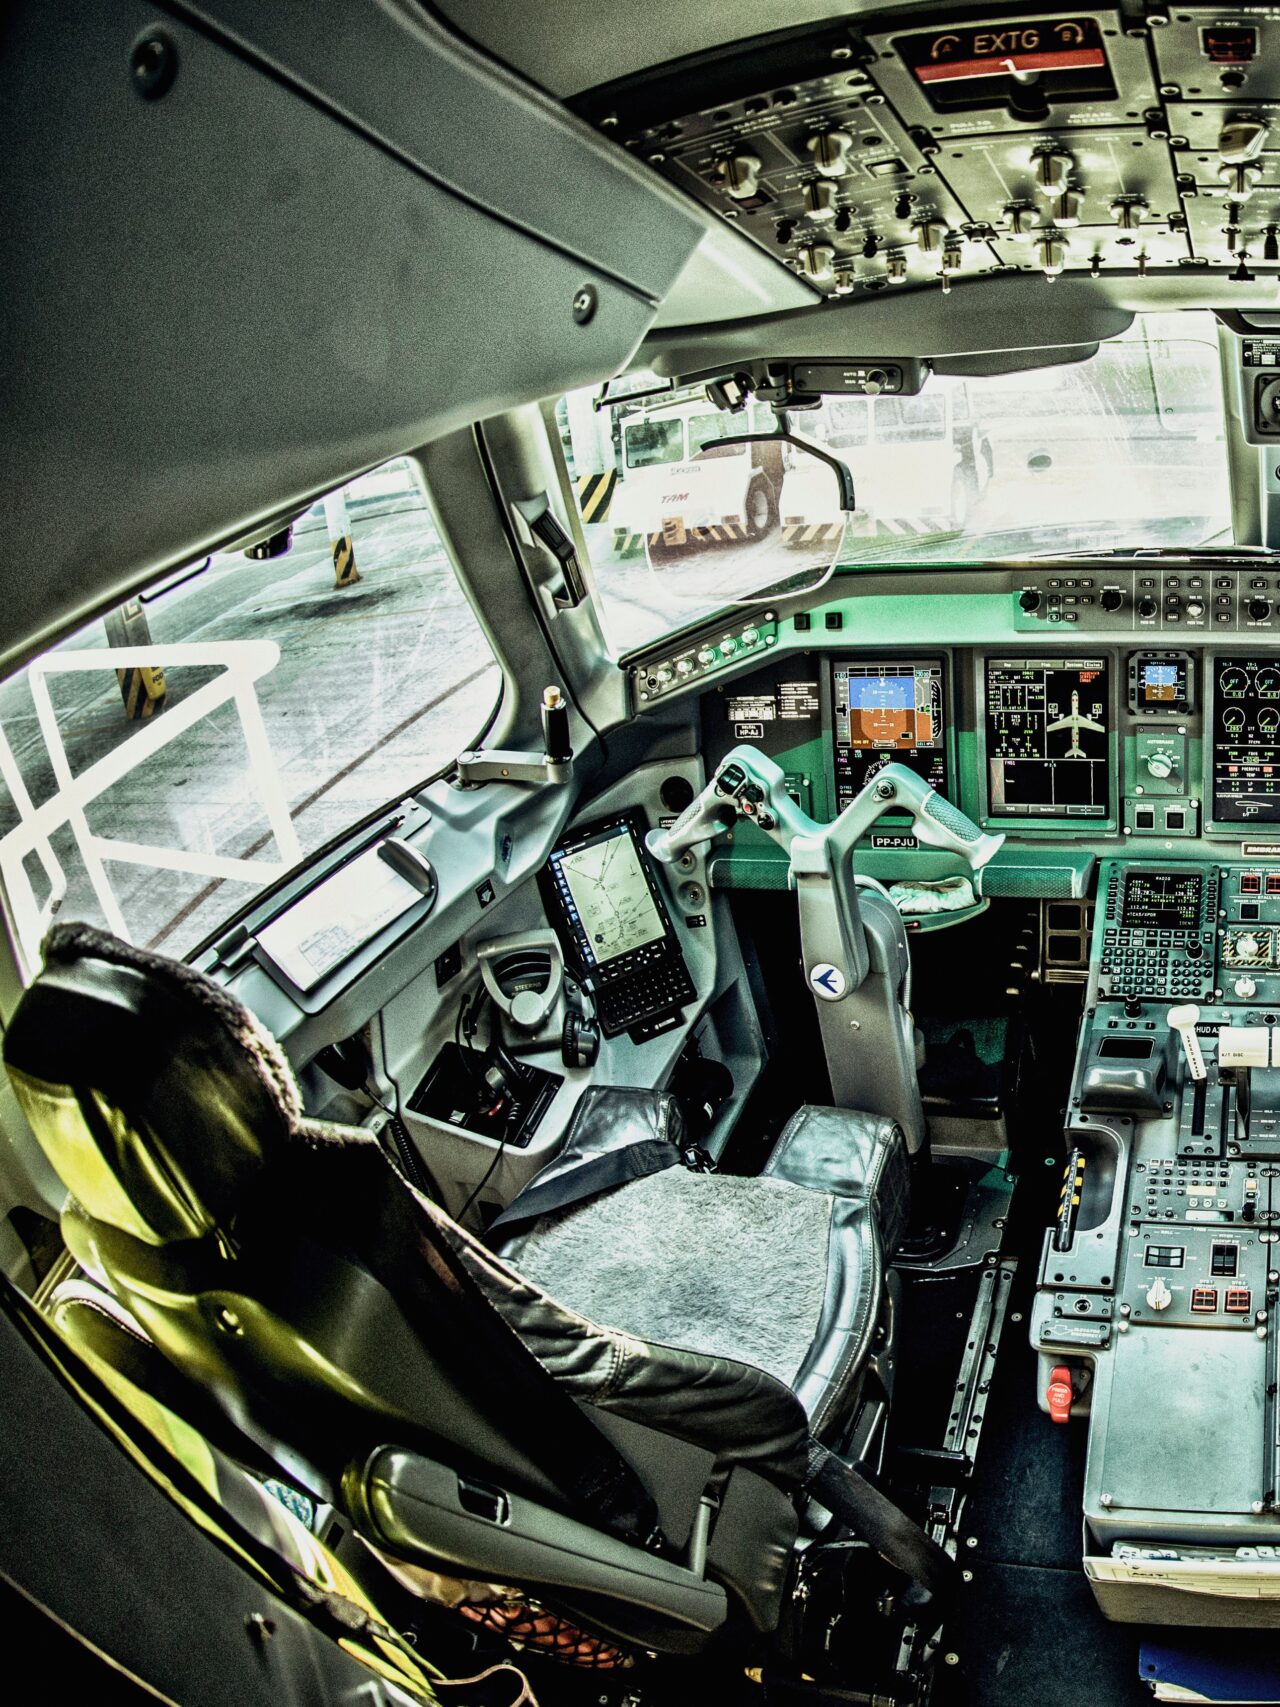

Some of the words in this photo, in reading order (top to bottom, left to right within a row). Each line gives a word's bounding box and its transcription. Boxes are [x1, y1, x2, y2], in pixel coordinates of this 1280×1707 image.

[973, 29, 1041, 55] EXTG
[661, 492, 690, 504] TAM
[876, 838, 915, 847] PP-PJU
